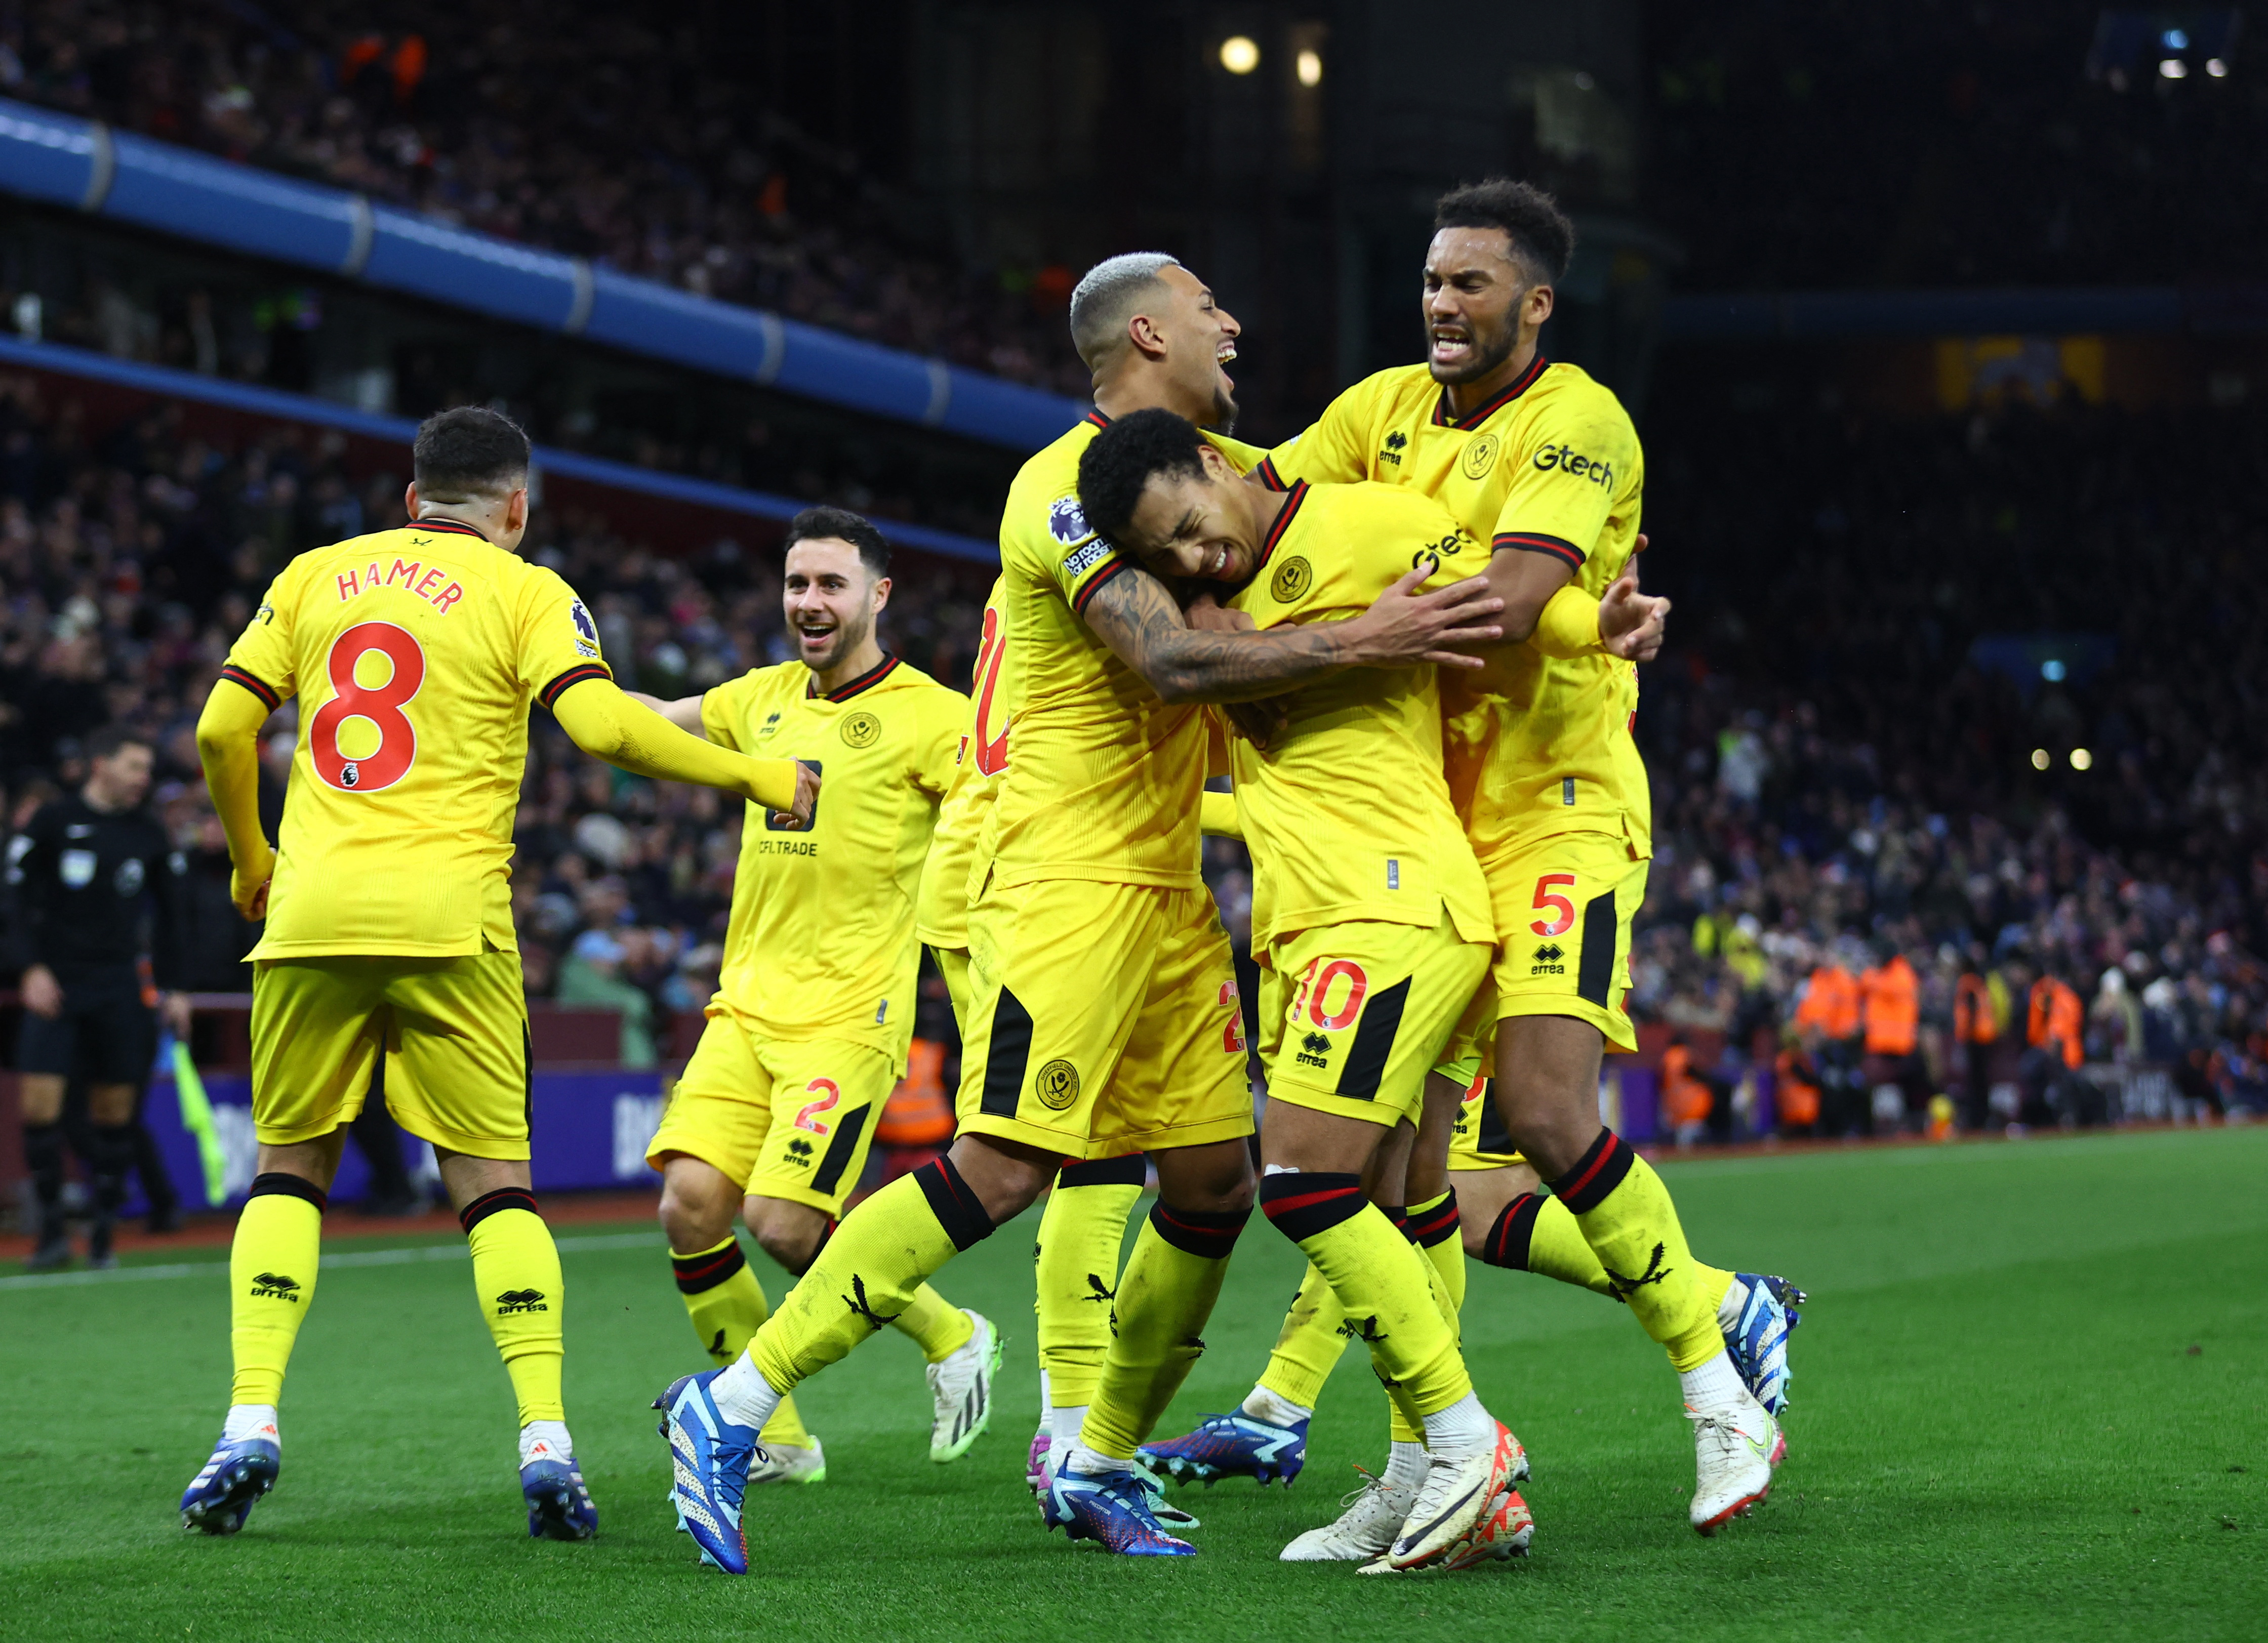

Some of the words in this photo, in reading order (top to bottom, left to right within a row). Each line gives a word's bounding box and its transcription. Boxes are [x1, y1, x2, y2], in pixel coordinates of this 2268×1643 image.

[1533, 444, 1613, 494] Gtech
[1063, 555, 1079, 570] No
[1069, 562, 1083, 578] for
[1412, 521, 1472, 576] Gtec
[337, 559, 463, 615] HAMER
[309, 621, 426, 793] 8
[1529, 874, 1575, 936] 5
[1218, 979, 1246, 1054] 2
[1291, 955, 1367, 1031] 10
[793, 1076, 841, 1137] 2
